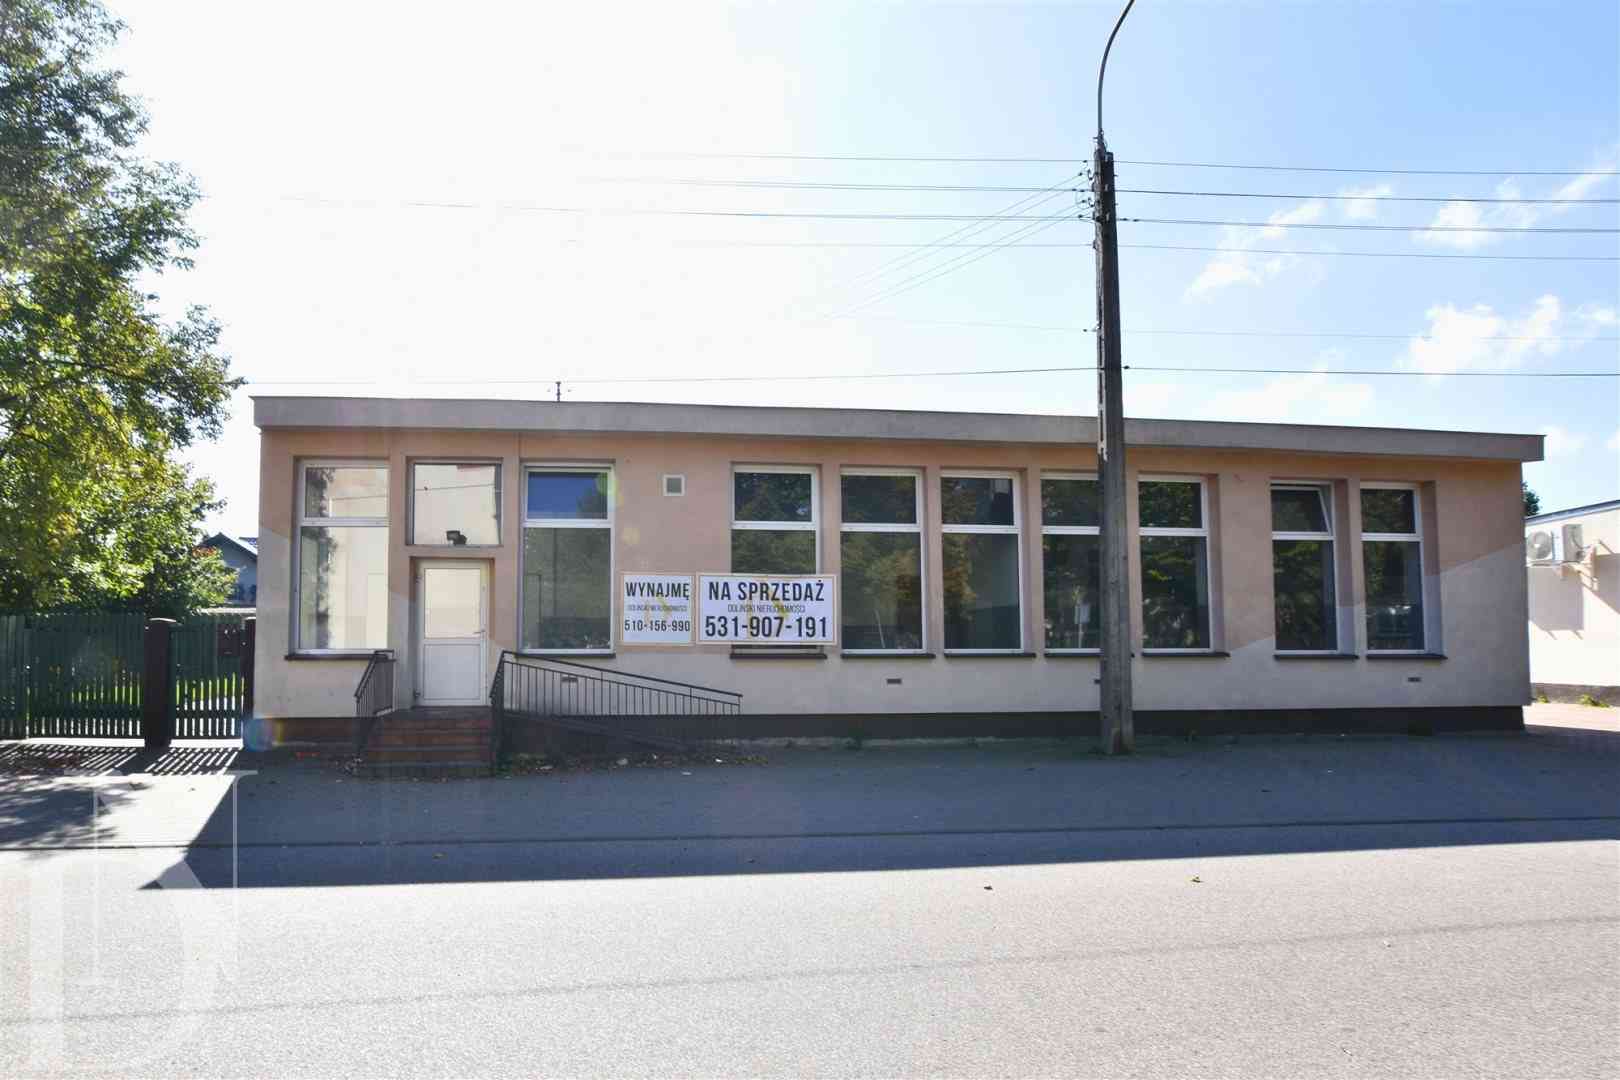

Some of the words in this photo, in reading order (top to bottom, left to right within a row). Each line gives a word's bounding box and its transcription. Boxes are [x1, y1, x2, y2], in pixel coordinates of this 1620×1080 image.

[625, 582, 690, 600] WYNAJMĘ
[708, 581, 731, 601] NA
[738, 579, 825, 601] SPRZEDAŻ
[624, 619, 691, 632] 510-156-990
[705, 615, 827, 638] 531-907-191
